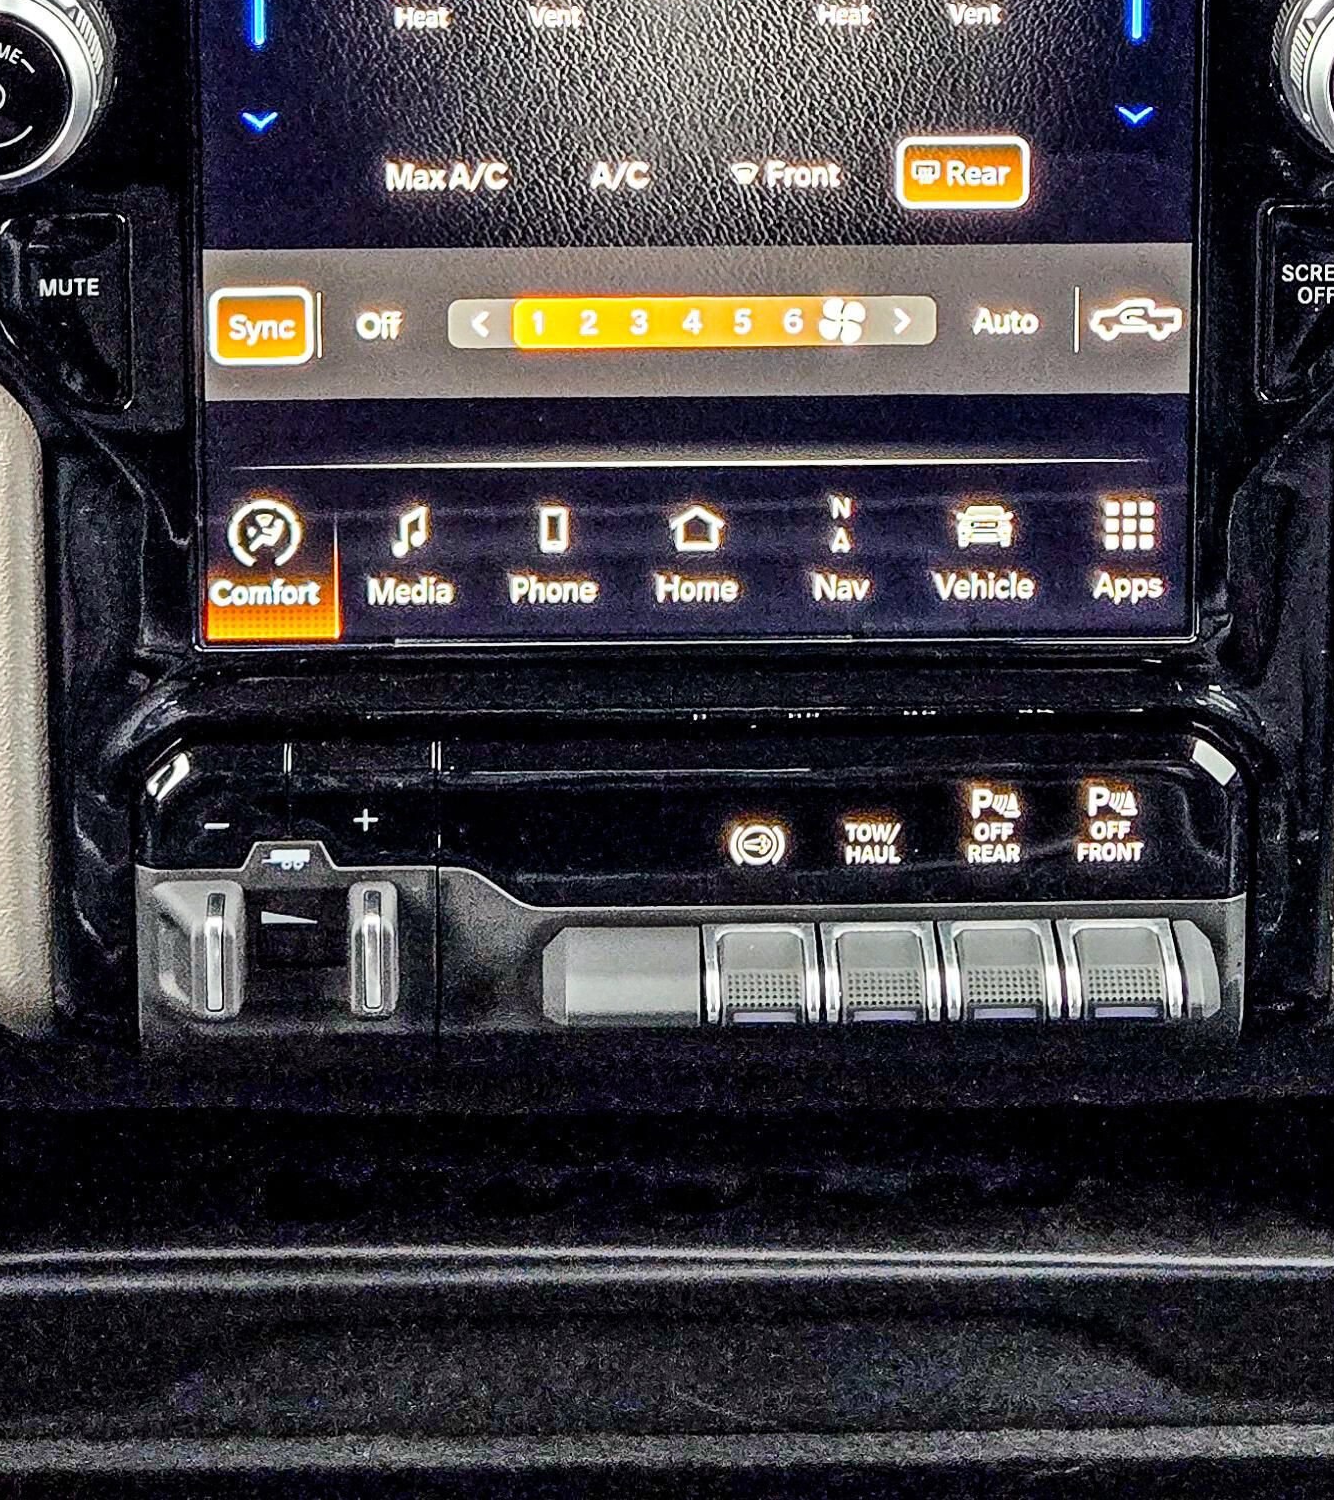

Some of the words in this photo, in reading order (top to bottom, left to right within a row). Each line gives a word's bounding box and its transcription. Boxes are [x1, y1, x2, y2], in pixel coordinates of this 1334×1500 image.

[393, 6, 452, 30] Heat
[530, 5, 582, 30] Vent
[817, 3, 872, 28] Heat
[948, 2, 1003, 28] Vent
[385, 163, 447, 190] Max
[450, 161, 510, 191] A/C
[591, 161, 652, 190] A/C
[767, 160, 842, 189] Front
[946, 160, 1011, 188] Rear
[38, 277, 101, 298] MUTE
[228, 313, 296, 347] Sync
[355, 310, 404, 341] Off
[531, 311, 545, 334] 1
[579, 309, 600, 335] 2
[629, 308, 649, 334] 3
[681, 308, 704, 333] 4
[733, 308, 753, 334] 5
[783, 308, 804, 334] 6
[972, 307, 1040, 335] Auto
[208, 578, 322, 608] Comfort
[367, 575, 455, 607] Media
[509, 575, 599, 605] Phone
[656, 574, 740, 604] Home
[813, 572, 871, 602] Nav
[933, 570, 1037, 601] Vehicle
[1093, 572, 1165, 605] Apps
[844, 823, 901, 844] TOW/
[973, 822, 1014, 842] OFF
[1090, 821, 1132, 840] OFF
[844, 844, 902, 865] HAUL
[968, 844, 1021, 863] REAR
[1077, 842, 1144, 862] FRONT
